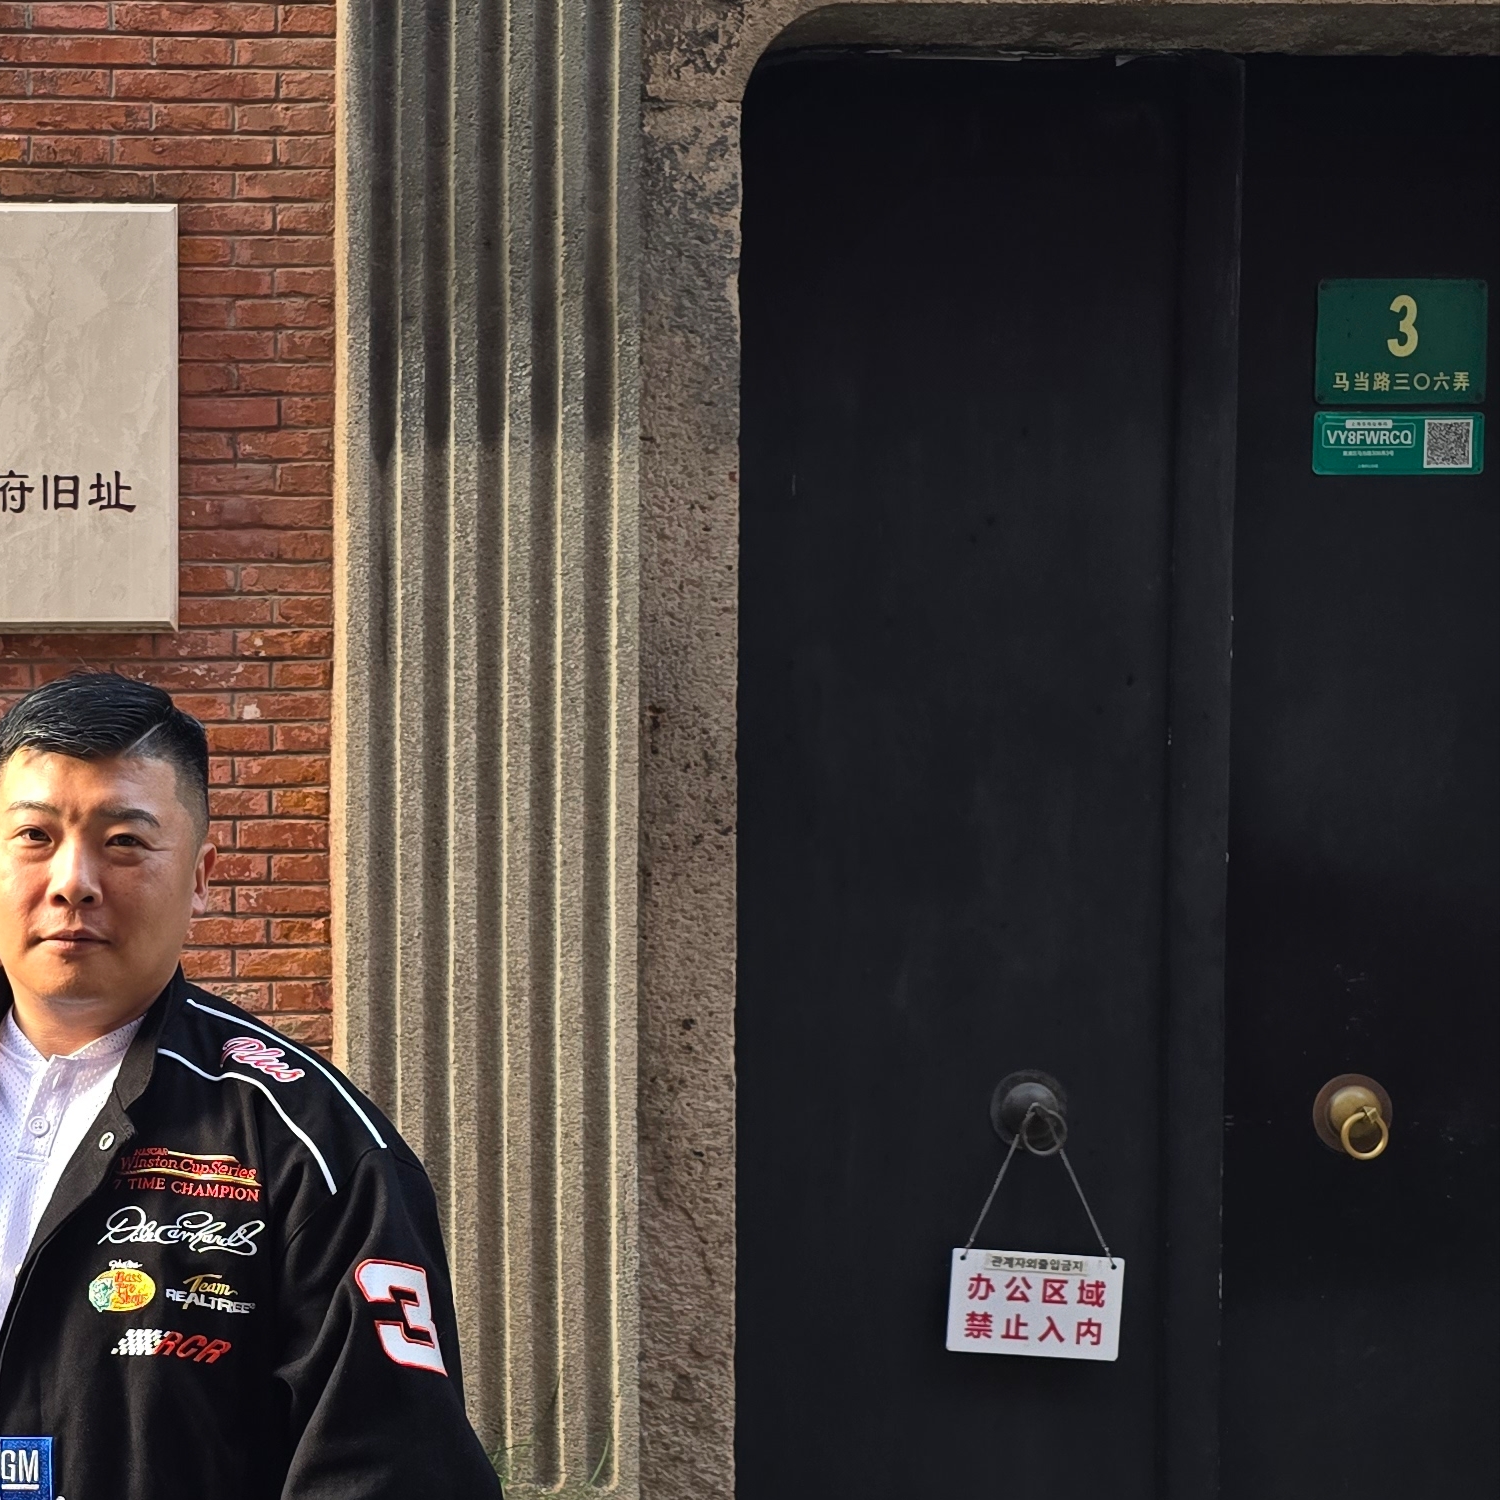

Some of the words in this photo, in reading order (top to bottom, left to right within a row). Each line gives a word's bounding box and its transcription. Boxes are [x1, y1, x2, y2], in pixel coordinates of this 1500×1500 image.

[1387, 294, 1419, 358] 3
[1326, 429, 1413, 445] VY8FWRCQ
[120, 1154, 181, 1172] Winston
[179, 1158, 212, 1178] Cup
[210, 1160, 257, 1180] Series
[127, 1178, 167, 1190] TIME
[171, 1181, 259, 1203] CHAMPION
[182, 1273, 238, 1302] Team
[966, 1273, 1106, 1308] 办公区域
[354, 1258, 449, 1378] 3
[963, 1310, 1102, 1346] 禁止入内
[0, 1448, 40, 1482] GM
